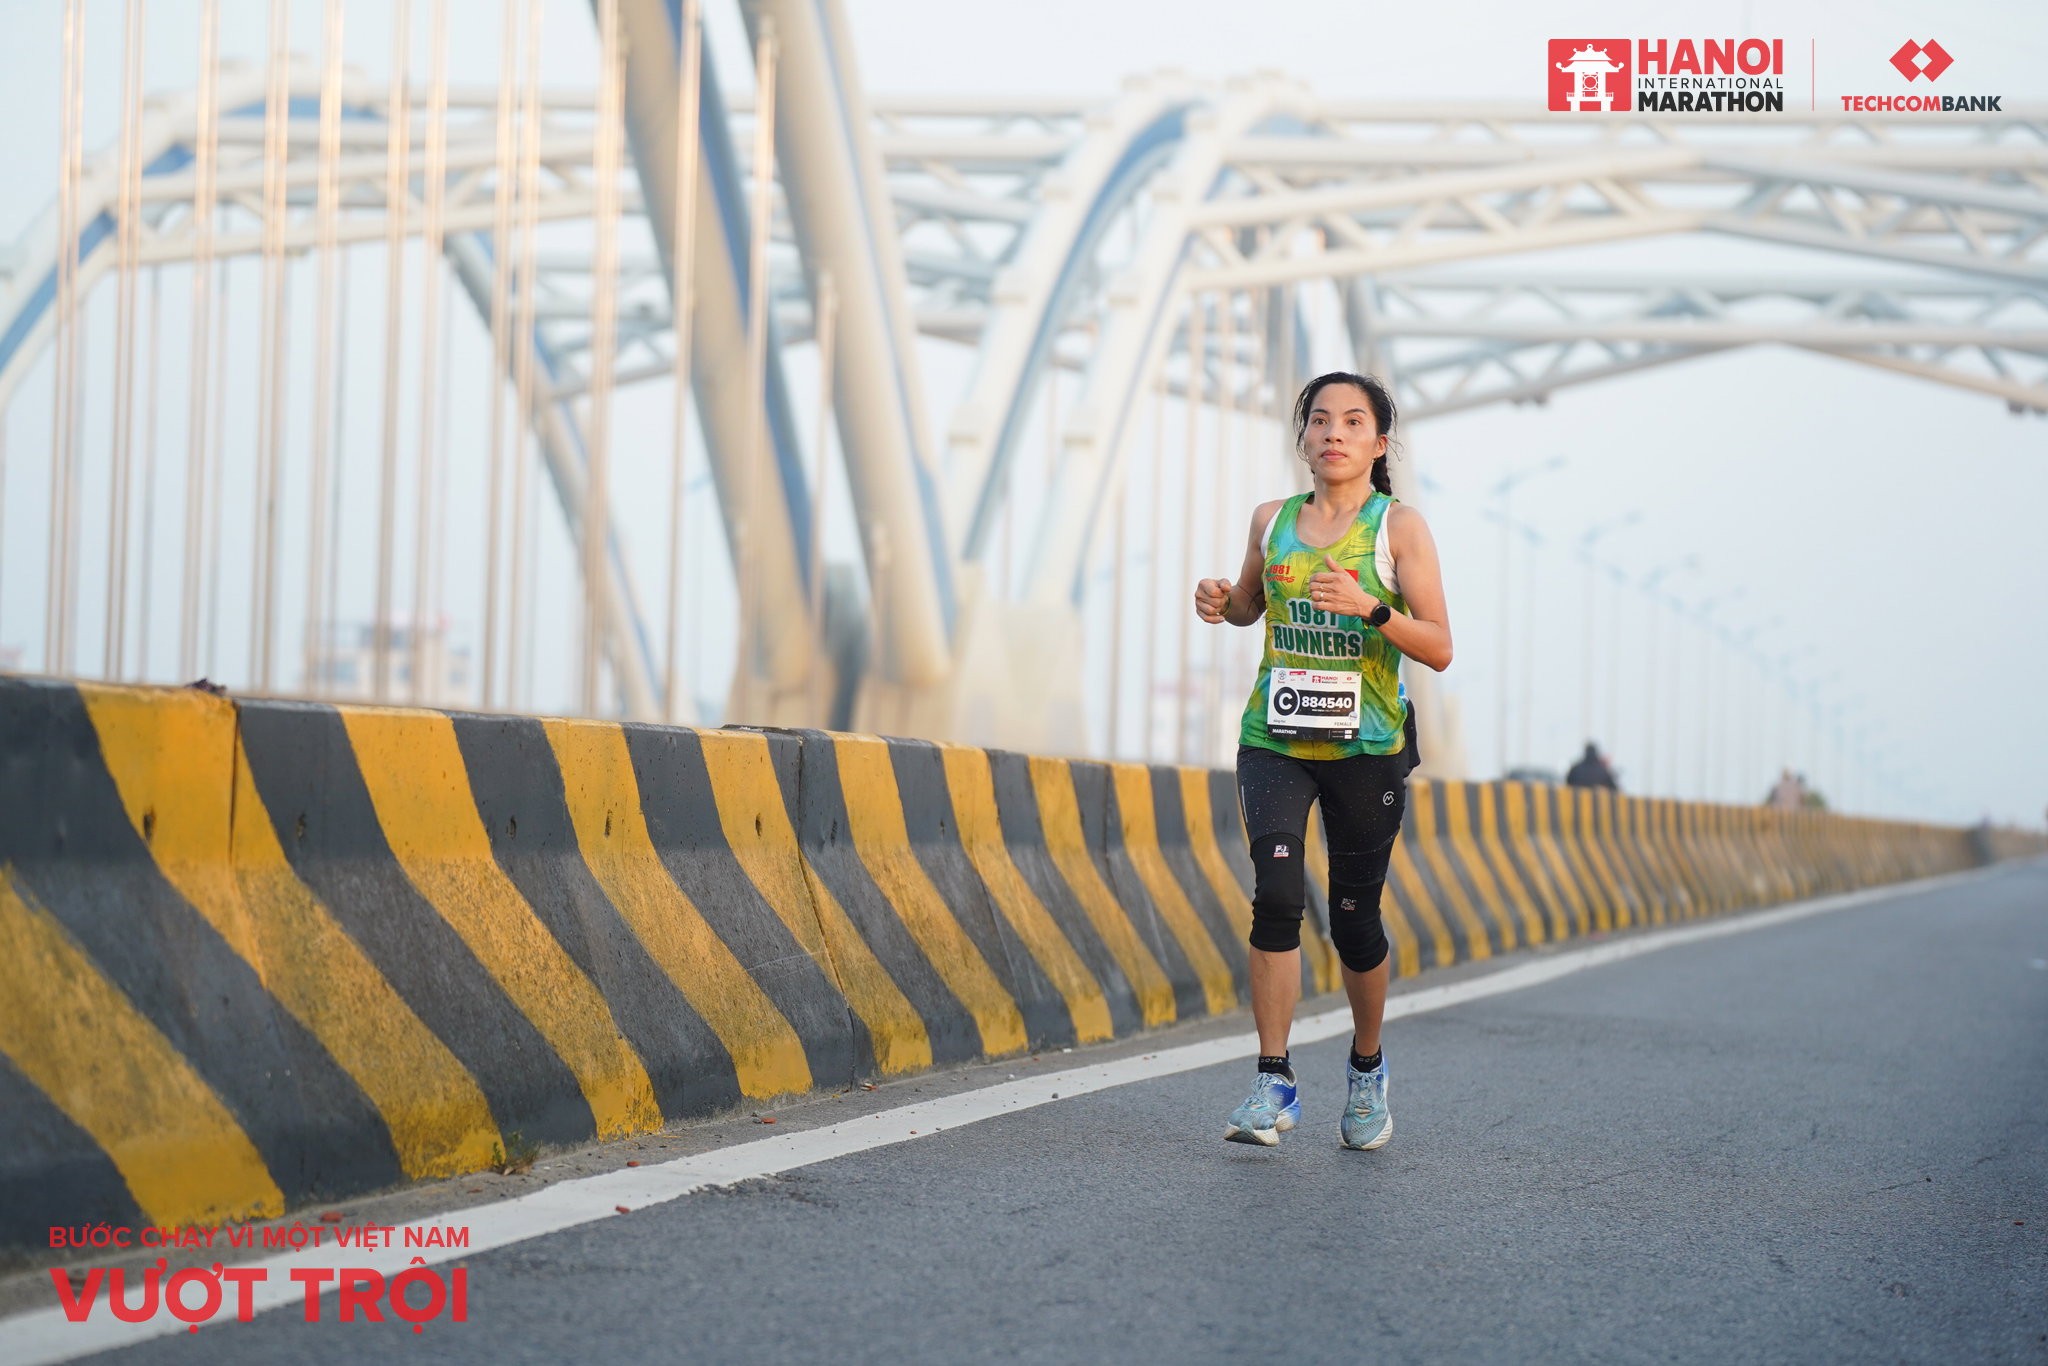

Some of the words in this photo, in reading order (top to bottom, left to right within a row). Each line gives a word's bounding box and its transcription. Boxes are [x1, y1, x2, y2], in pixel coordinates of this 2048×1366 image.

[1272, 625, 1361, 657] RUNNERS
[1278, 692, 1293, 710] C
[1301, 696, 1352, 709] 884540
